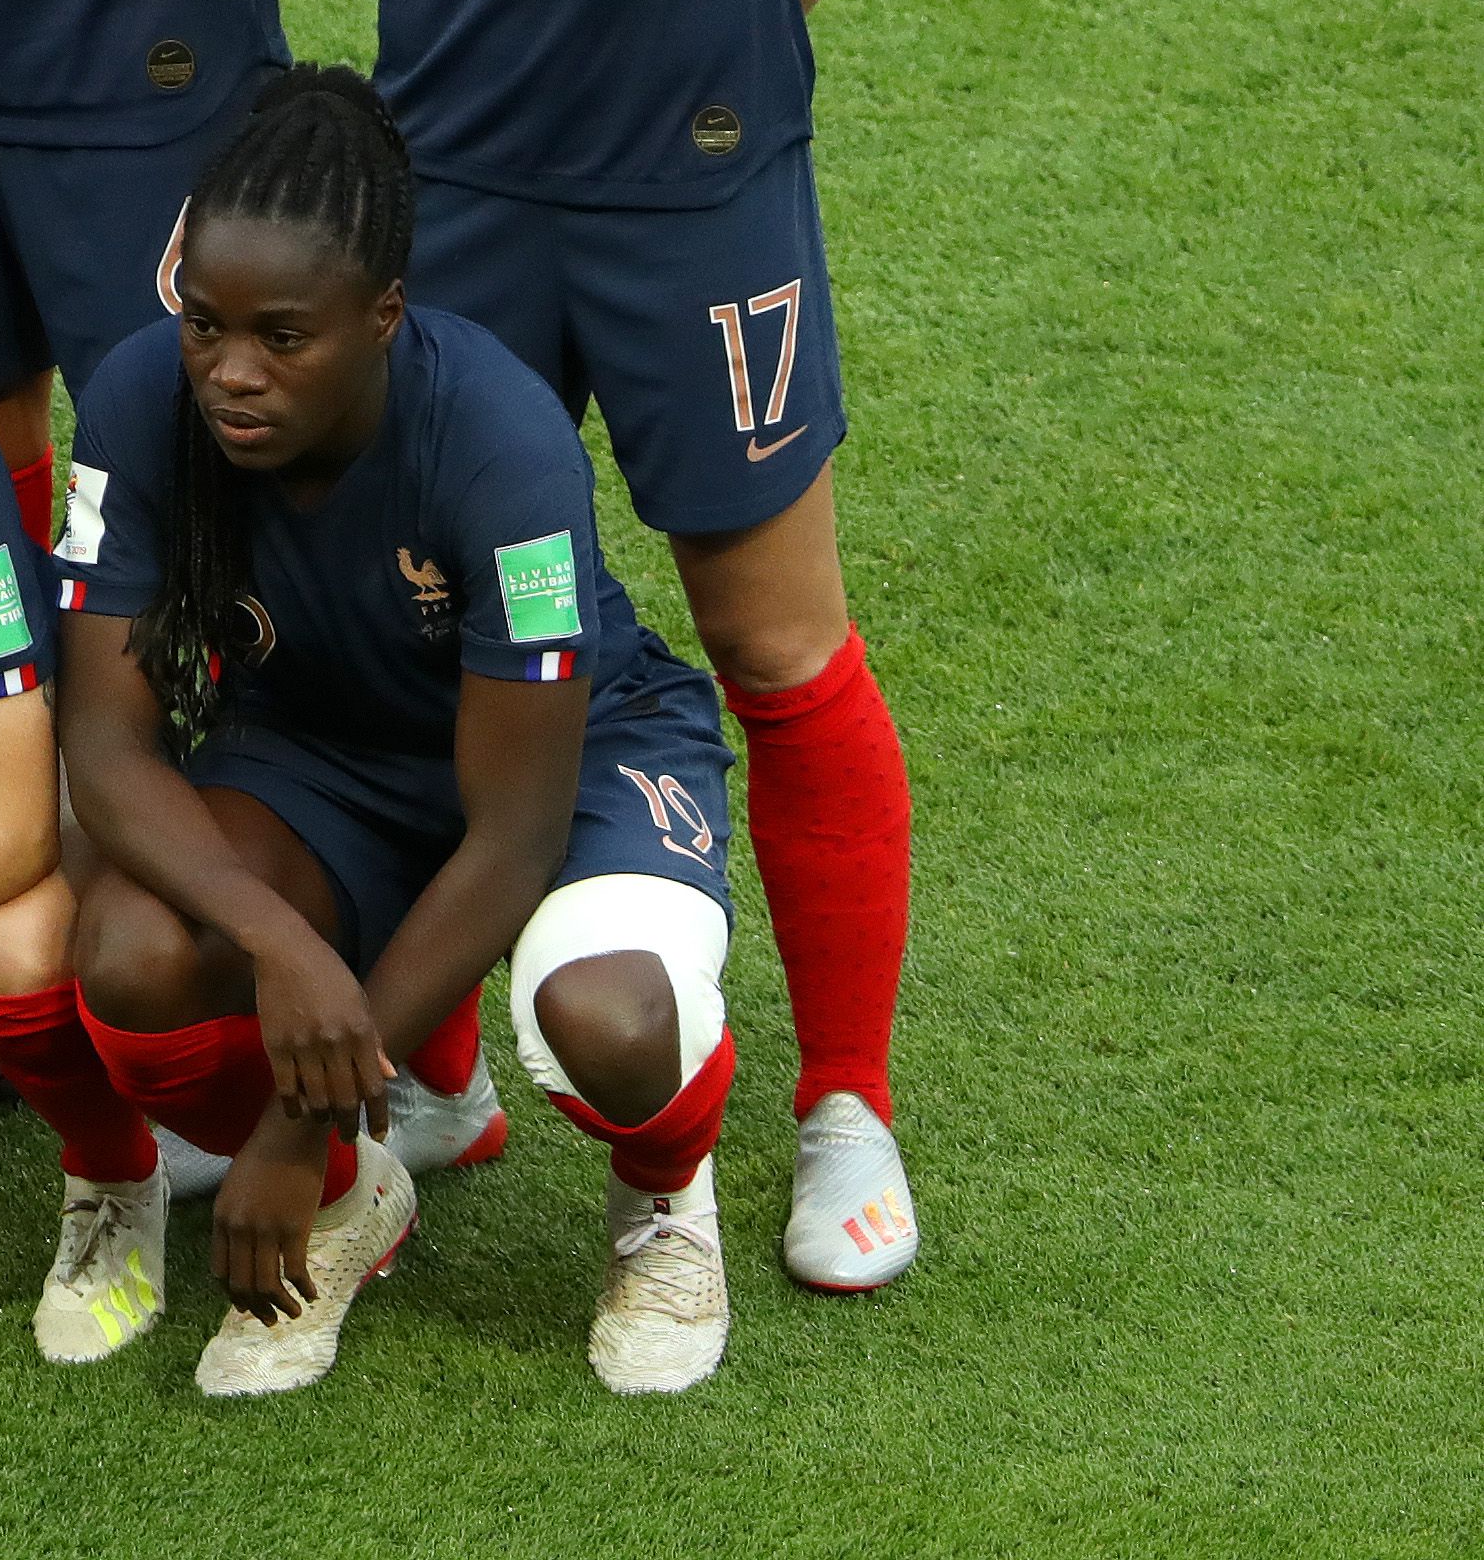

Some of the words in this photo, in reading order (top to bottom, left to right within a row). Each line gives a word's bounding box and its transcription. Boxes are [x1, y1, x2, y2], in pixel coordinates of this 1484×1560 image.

[709, 278, 801, 432] 17
[508, 560, 572, 584] LIVING
[617, 763, 714, 856] 19
